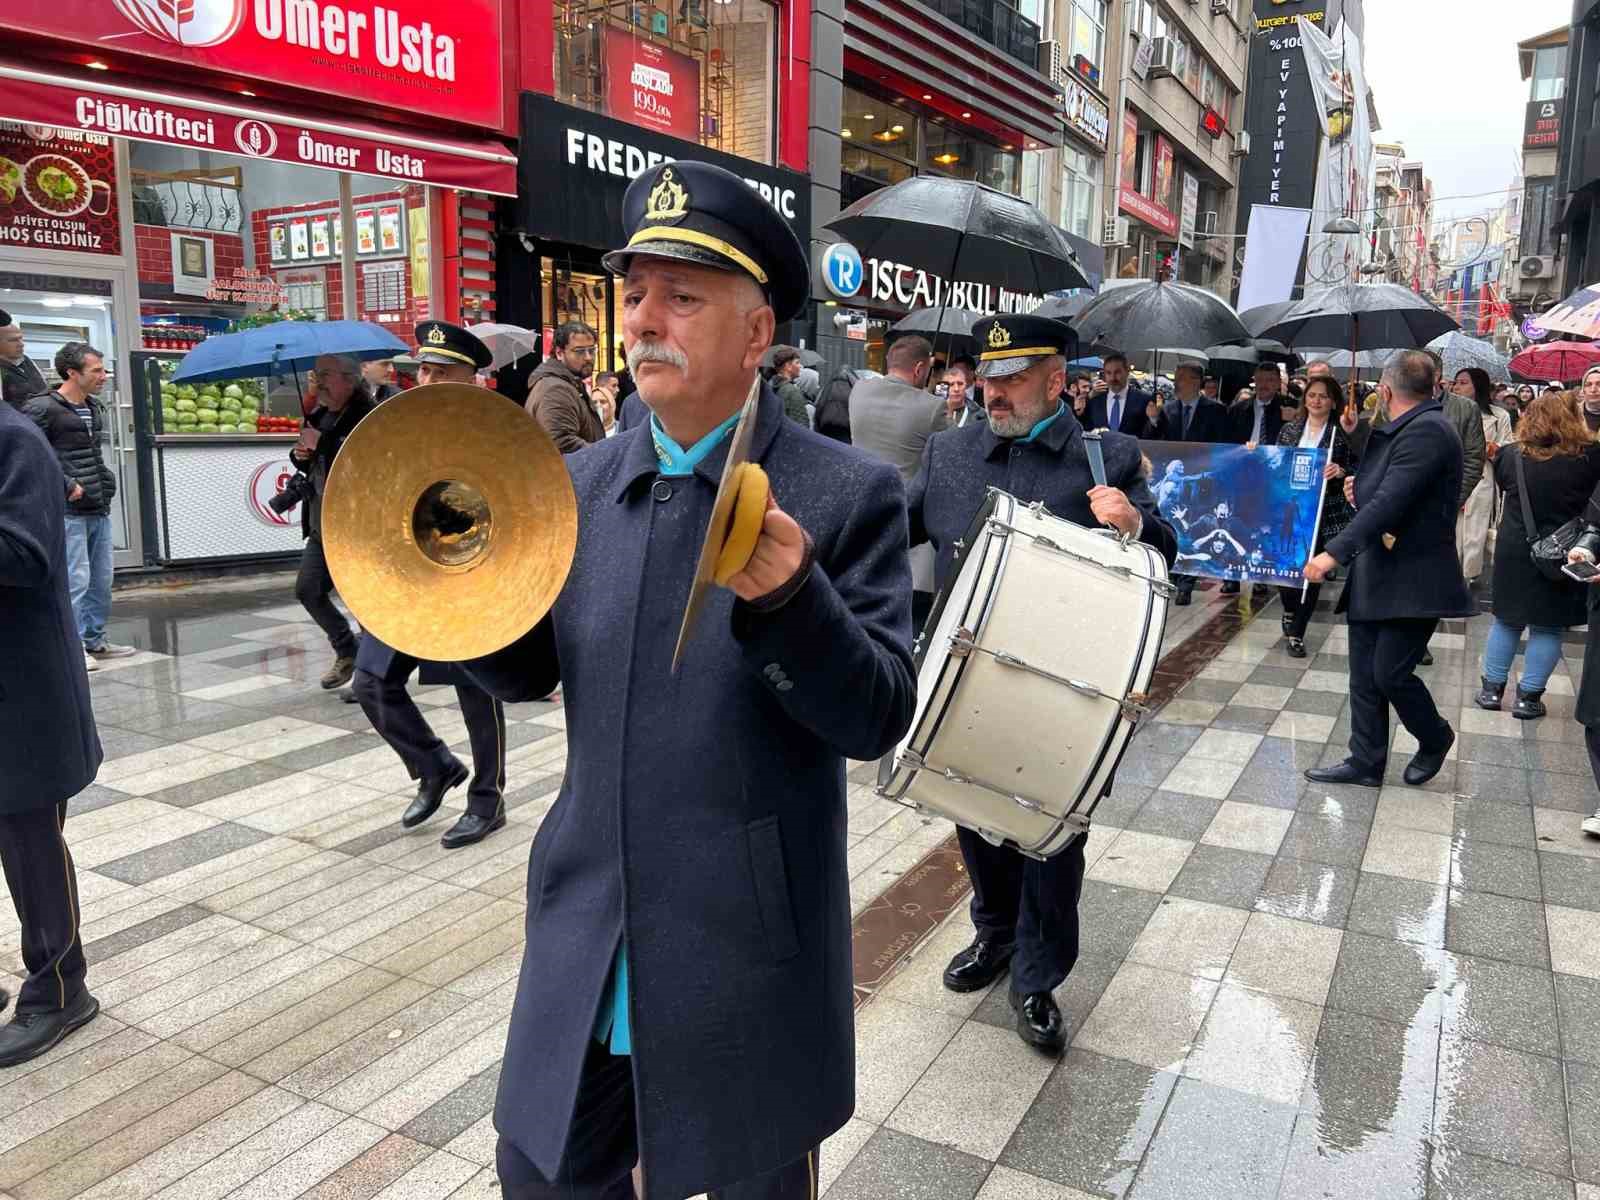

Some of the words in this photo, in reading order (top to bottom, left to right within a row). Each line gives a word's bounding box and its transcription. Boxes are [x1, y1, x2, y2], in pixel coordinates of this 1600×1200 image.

[1256, 15, 1288, 28] urger
[374, 6, 455, 81] Usta
[1269, 37, 1304, 50] %100
[1279, 58, 1290, 82] EV
[75, 96, 215, 145] Çiğköfteci
[298, 130, 361, 168] Ömer
[376, 148, 424, 178] Usta
[567, 128, 677, 179] FRED
[14, 214, 48, 228] AFİYET
[51, 219, 85, 231] OLSUN
[34, 229, 101, 248] GELDİNİZ
